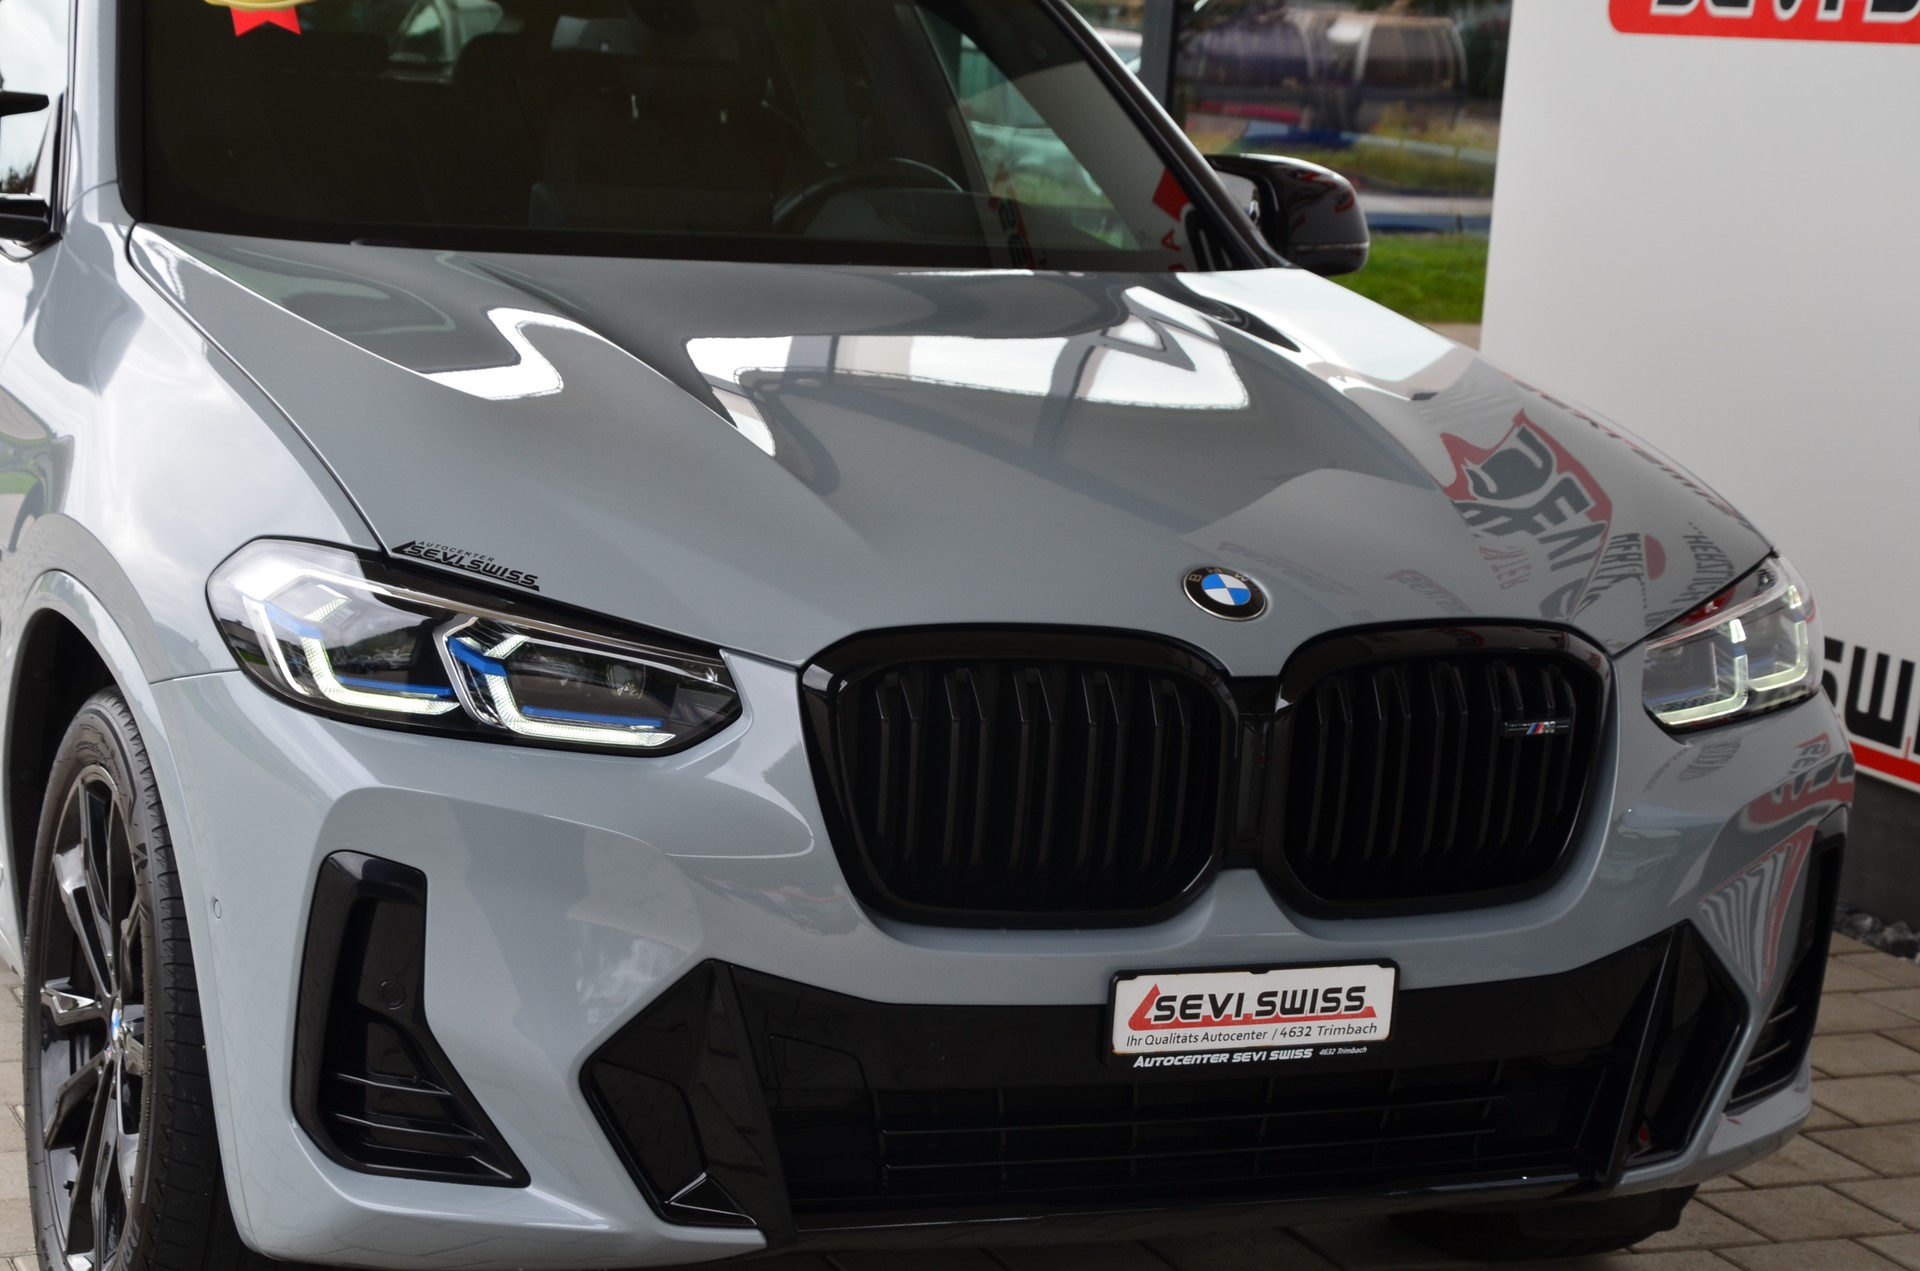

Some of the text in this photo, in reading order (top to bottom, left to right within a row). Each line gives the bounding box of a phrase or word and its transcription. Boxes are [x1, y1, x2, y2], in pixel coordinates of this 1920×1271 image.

[419, 541, 495, 562] AUTOCENTER
[467, 560, 538, 584] SWISS
[1153, 985, 1366, 1022] SEVI SWISS
[1126, 1035, 1143, 1047] Ihr
[1200, 1030, 1268, 1043] Autocenter
[1318, 1022, 1377, 1036] Trimbach
[1133, 1045, 1367, 1069] AUTOCENTER SEVI SWISS 4632 Trimbach
